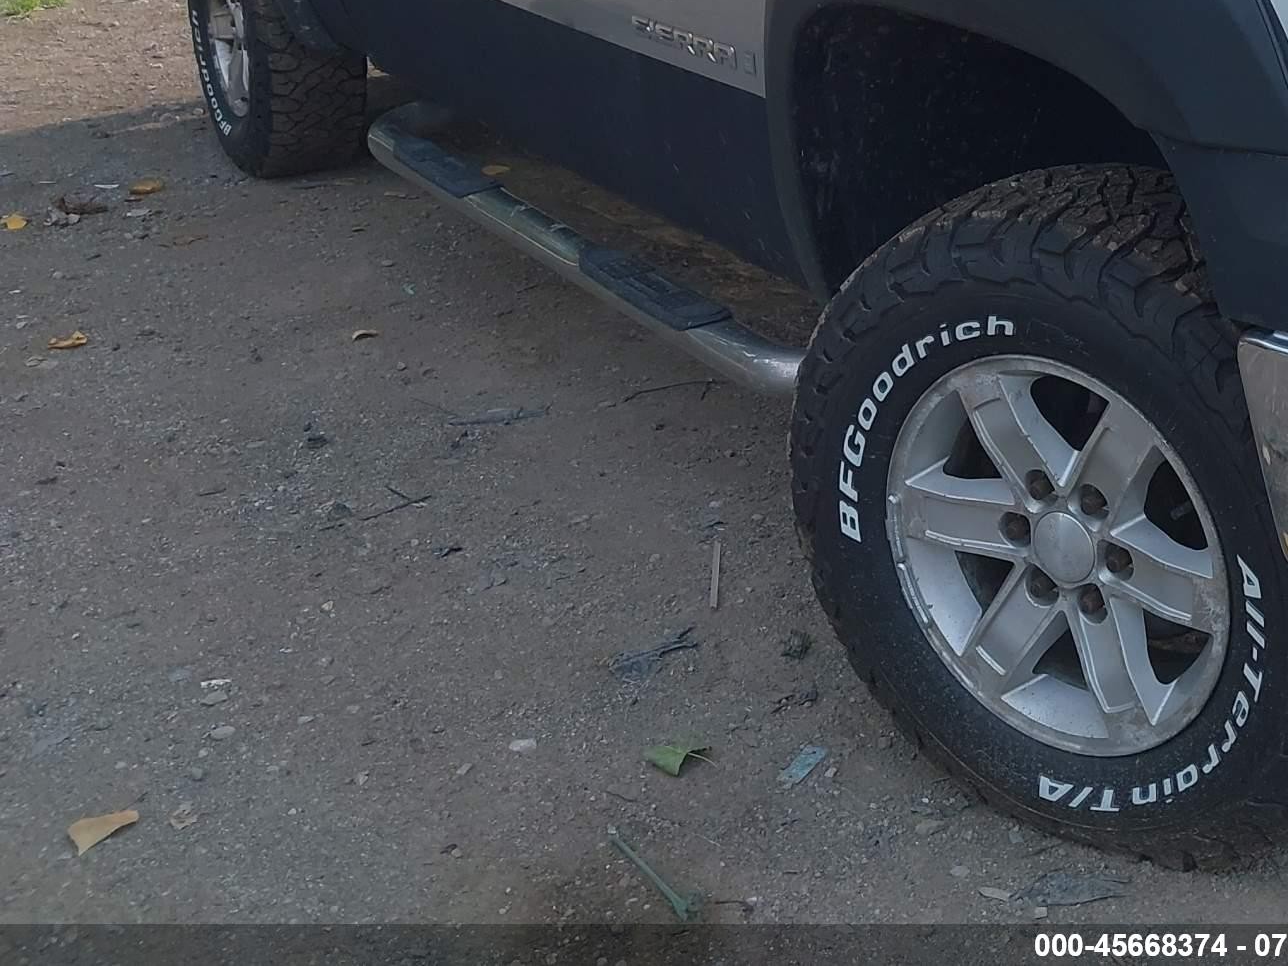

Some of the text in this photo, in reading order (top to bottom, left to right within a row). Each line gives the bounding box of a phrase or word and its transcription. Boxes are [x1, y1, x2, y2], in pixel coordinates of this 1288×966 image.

[838, 315, 1015, 543] BFGoodrich
[1038, 554, 1266, 813] All-Terrain T/A
